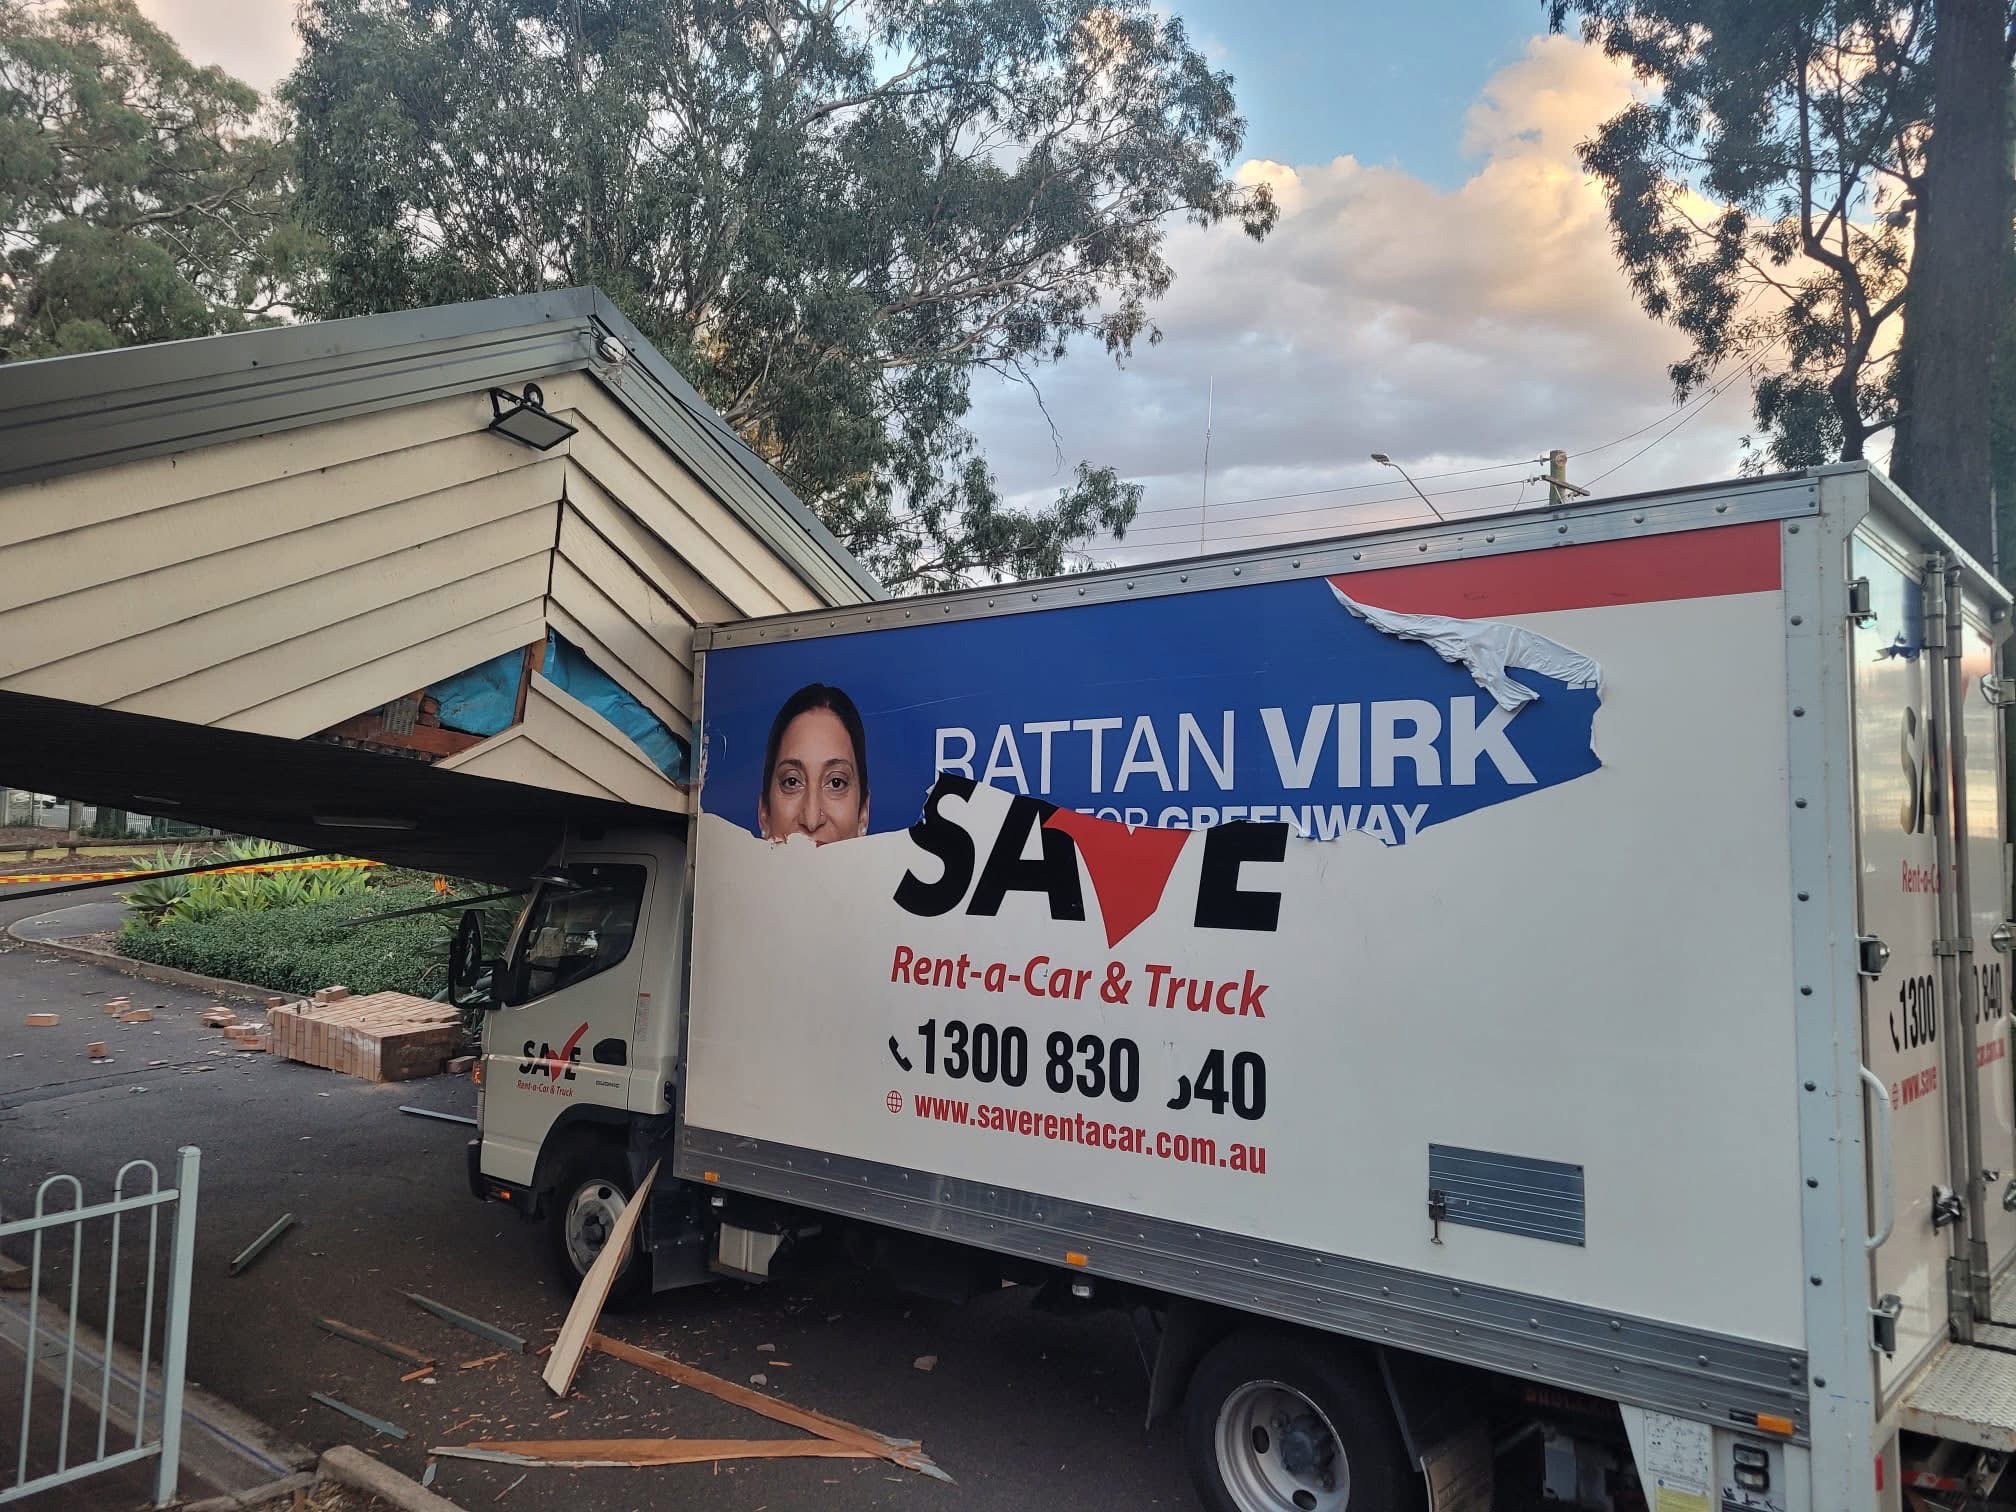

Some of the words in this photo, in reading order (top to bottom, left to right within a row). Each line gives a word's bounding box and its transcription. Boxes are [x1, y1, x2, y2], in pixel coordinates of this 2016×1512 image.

[934, 709, 1235, 796] RATTAN
[1259, 696, 1538, 789] VIRK
[893, 771, 1290, 949] SAVE
[891, 944, 1093, 1001] Rent-a-Car
[1100, 961, 1133, 1005] &
[1145, 964, 1270, 1018] Truck
[1900, 974, 1935, 1050] 1300
[516, 1079, 550, 1094] Rent-a-Car
[557, 1086, 575, 1097] Truck
[519, 1023, 588, 1083] SAVE
[918, 1018, 1028, 1087] 1300
[1046, 1031, 1140, 1103] 830
[914, 1094, 1267, 1175] www.saverentacar.com.au
